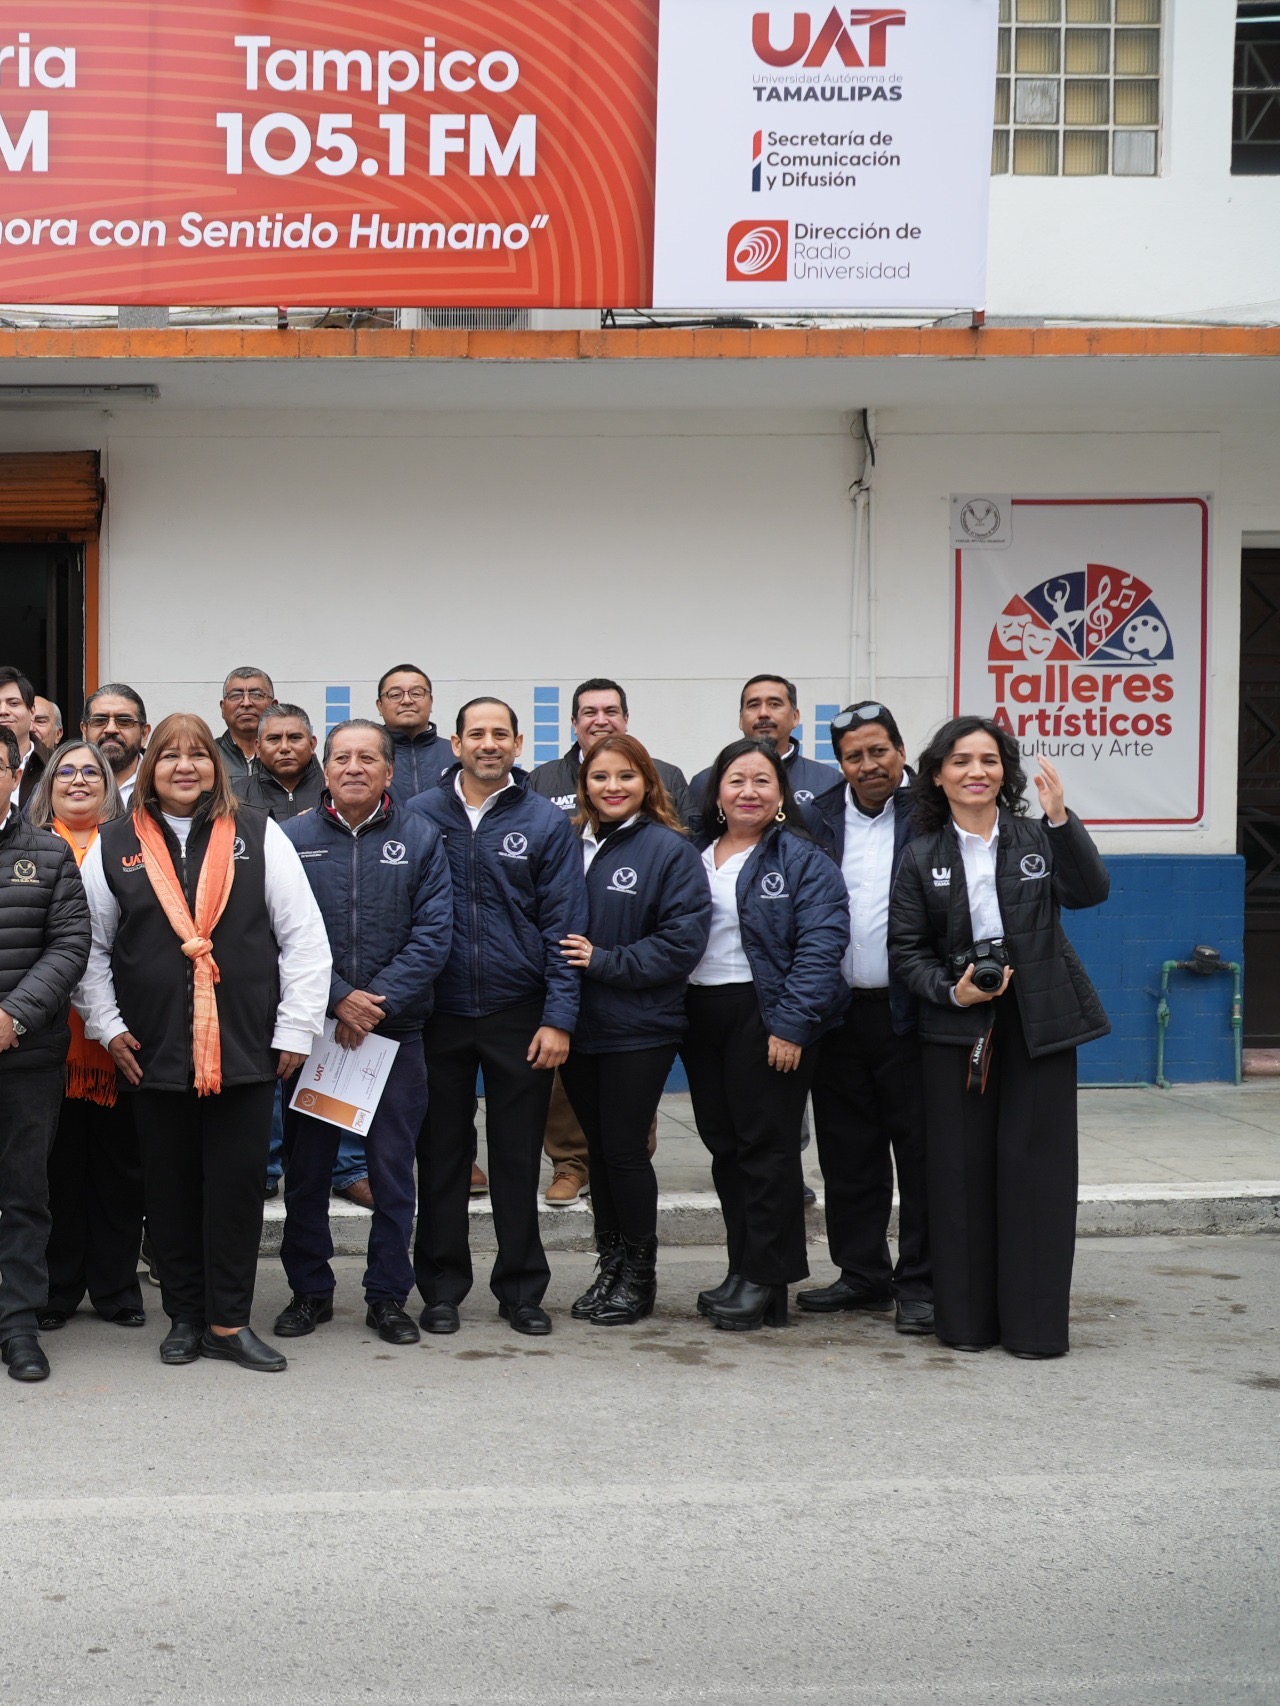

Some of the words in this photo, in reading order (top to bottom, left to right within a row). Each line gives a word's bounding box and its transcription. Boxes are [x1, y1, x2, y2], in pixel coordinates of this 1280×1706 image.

[752, 5, 907, 67] UAT
[234, 36, 520, 105] Tampico
[753, 74, 820, 84] Universidad
[824, 73, 885, 84] Autónoma
[889, 74, 903, 84] de
[753, 86, 902, 102] TAMAULIPAS
[217, 112, 406, 176] 105.1
[429, 114, 537, 177] FM
[767, 130, 865, 146] Secretaría
[870, 131, 893, 146] de
[767, 150, 901, 167] Comunicación
[767, 175, 777, 190] y
[783, 171, 856, 187] Difusión
[89, 219, 167, 247] con
[178, 212, 339, 249] Sentido
[795, 222, 890, 240] Dirección
[896, 223, 922, 240] de
[795, 243, 851, 260] Radio
[795, 262, 910, 279] Universidad
[988, 664, 1174, 703] Talleres
[993, 705, 1172, 737] Artísticos
[1021, 739, 1084, 757] ultura
[1091, 743, 1103, 761] y
[1109, 739, 1153, 757] Arte
